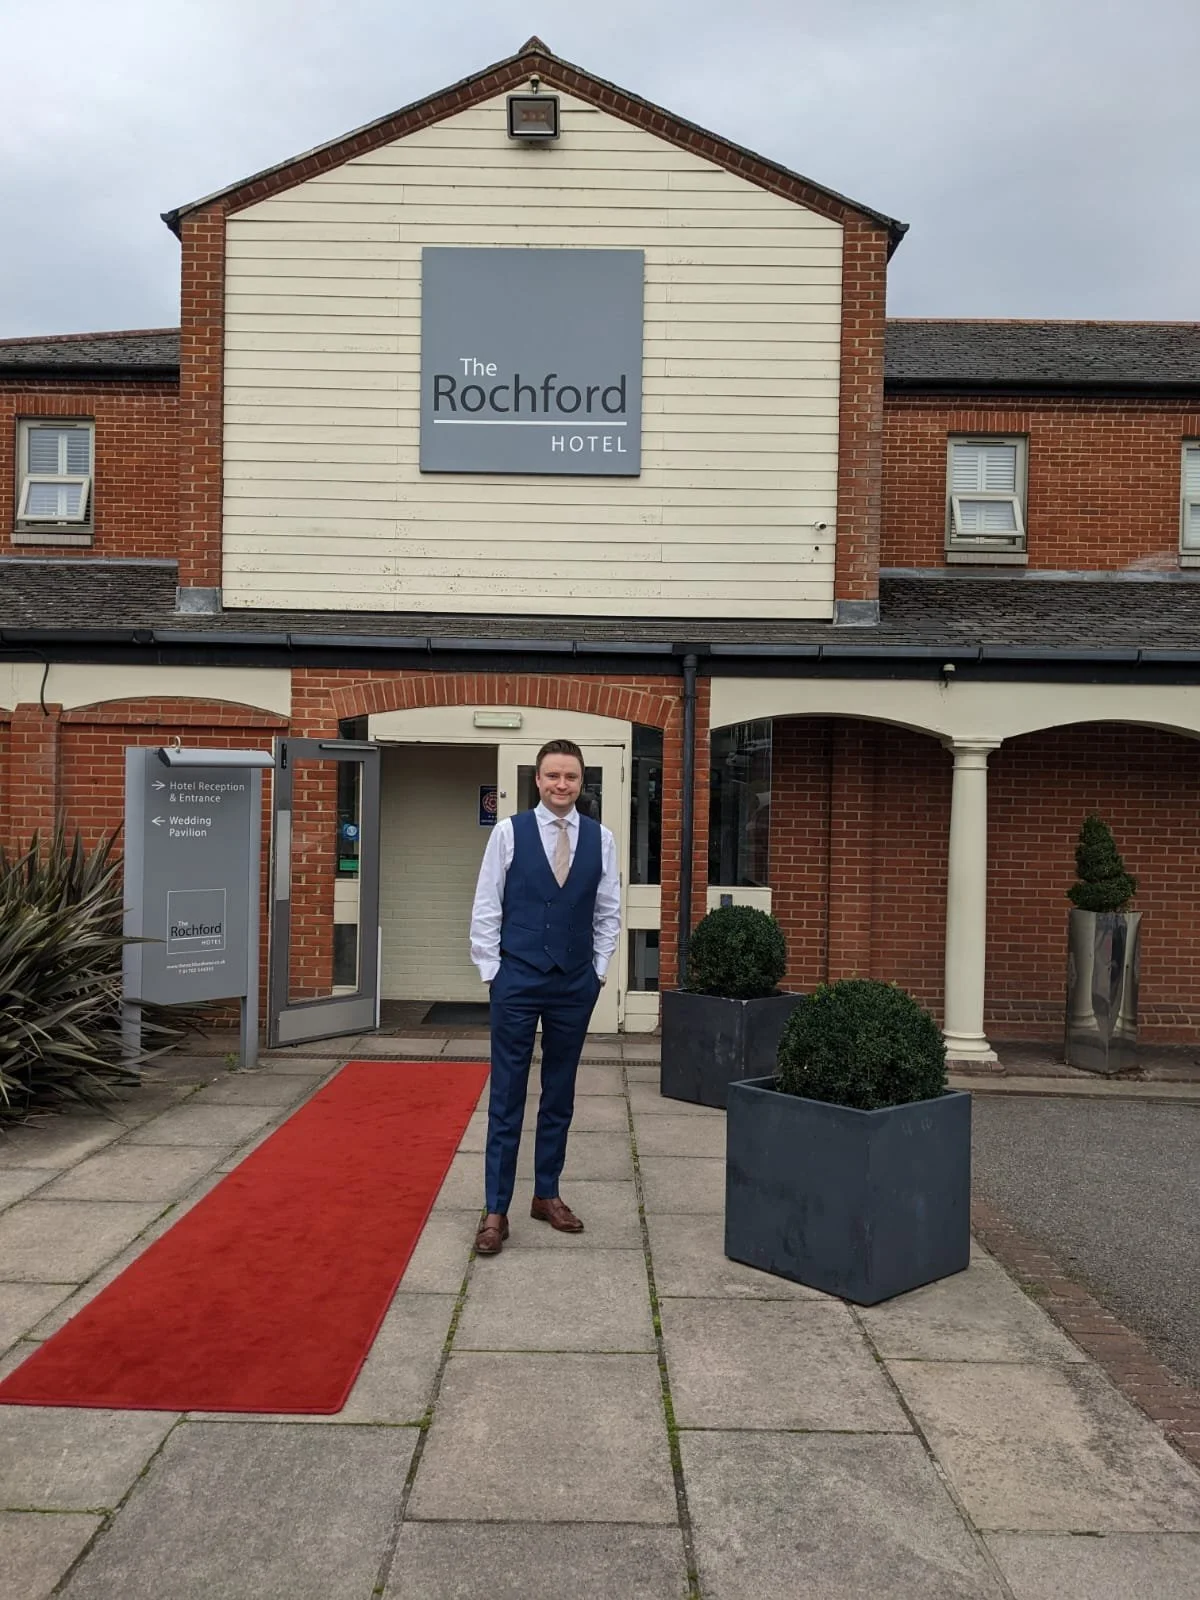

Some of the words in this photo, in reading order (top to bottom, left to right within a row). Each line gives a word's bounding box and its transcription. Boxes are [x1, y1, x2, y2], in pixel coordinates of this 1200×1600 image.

[459, 357, 497, 377] The
[433, 373, 627, 414] Rochford
[551, 435, 627, 453] HOTEL
[169, 781, 196, 791] Hotel
[198, 781, 245, 792] Reception
[169, 793, 177, 802] &
[179, 793, 221, 803] Entrance
[169, 816, 212, 827] Wedding
[169, 827, 207, 837] Pavilion
[170, 922, 222, 937] Rochford
